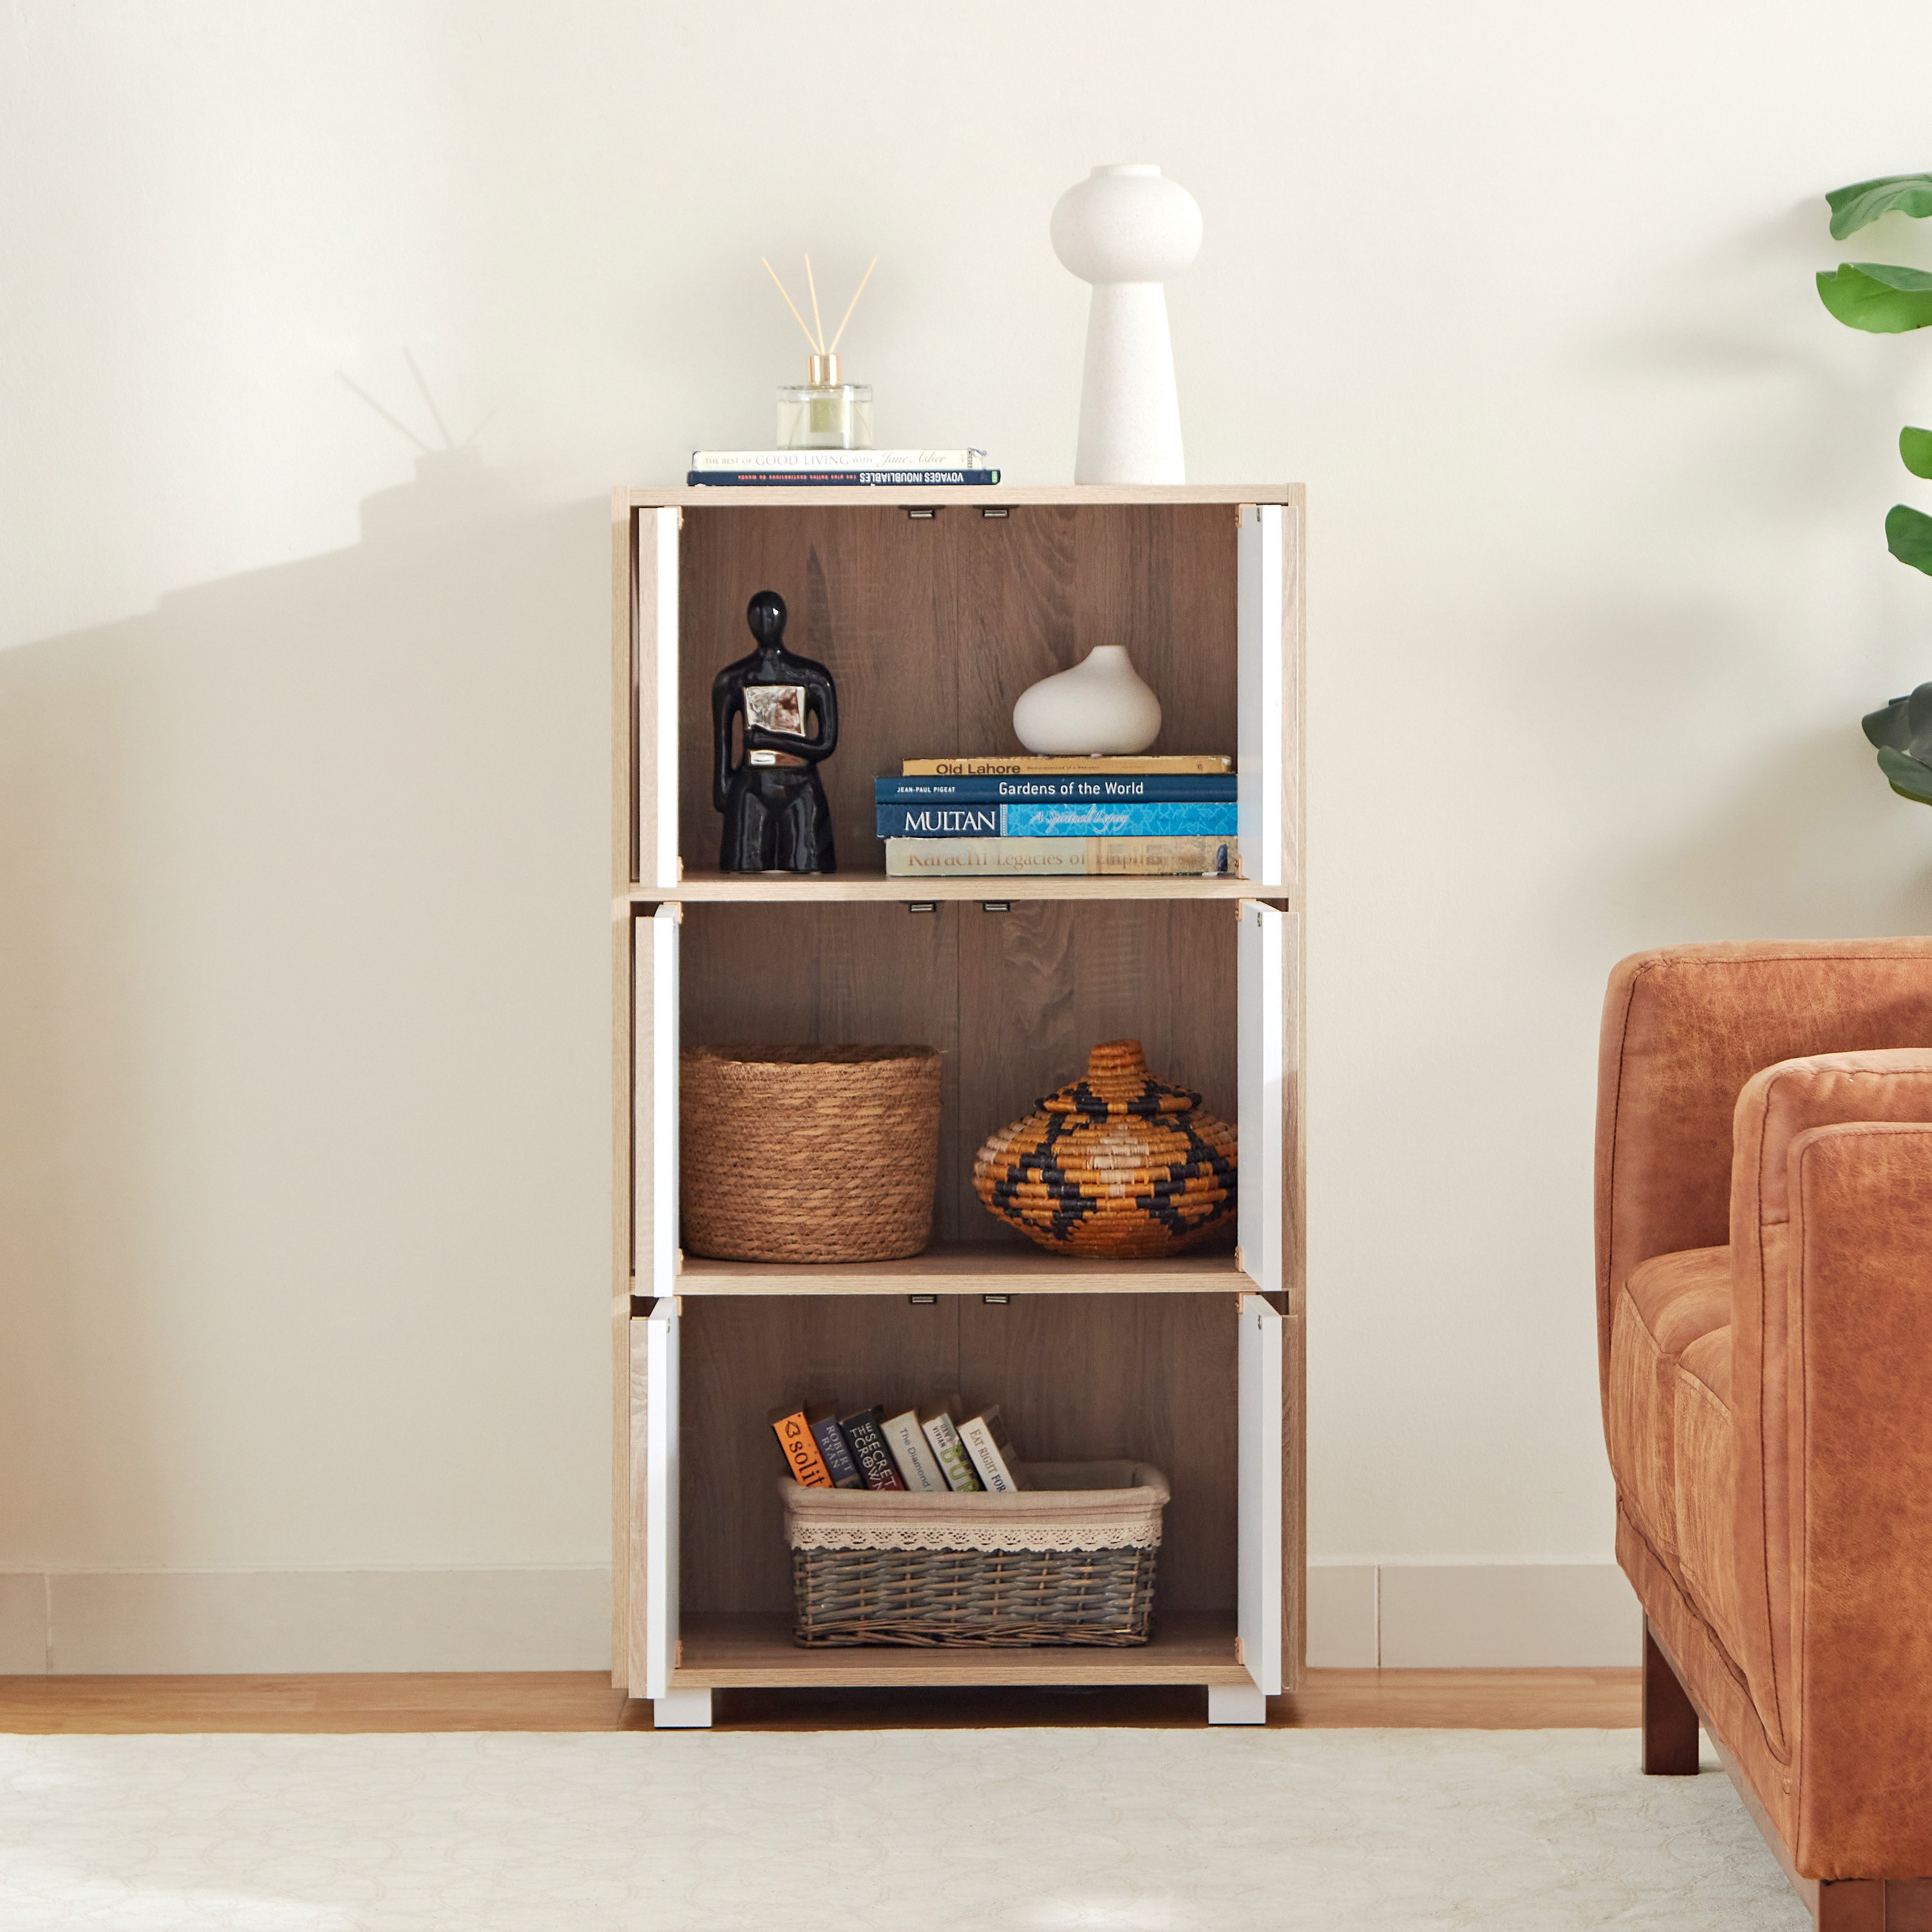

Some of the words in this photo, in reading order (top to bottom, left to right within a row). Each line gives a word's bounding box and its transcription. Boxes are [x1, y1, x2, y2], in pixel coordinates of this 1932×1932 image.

[755, 455, 799, 466] GOOD
[804, 454, 849, 465] LIVING
[876, 451, 907, 468] Jane
[910, 451, 947, 464] Asher
[859, 472, 922, 483] INOUBLIABLES
[924, 472, 964, 483] VOYAGES
[936, 763, 963, 774] Old
[968, 764, 1021, 774] Lahore
[999, 781, 1056, 795] Gardens
[1060, 781, 1075, 795] of
[1078, 781, 1101, 795] the
[1104, 781, 1144, 795] World
[905, 811, 996, 831] MULTAN
[1030, 811, 1043, 824] A
[1045, 804, 1097, 833] Spiritual
[1094, 810, 1130, 833] Legacy
[908, 849, 988, 866] Karachi
[997, 853, 1063, 869] Legacies
[1069, 851, 1085, 866] of
[826, 1425, 853, 1472] ROBERT
[933, 1425, 947, 1448] VIVIAN
[789, 1441, 825, 1487] solit
[821, 1437, 840, 1468] RYAN
[849, 1422, 873, 1437] THE
[865, 1433, 897, 1487] SECRET
[855, 1437, 886, 1490] CROWN
[900, 1427, 911, 1445] The
[908, 1446, 931, 1488] Diamond
[970, 1428, 983, 1446] EAT
[978, 1449, 998, 1473] RIGHT
[991, 1473, 1007, 1492] FOR
